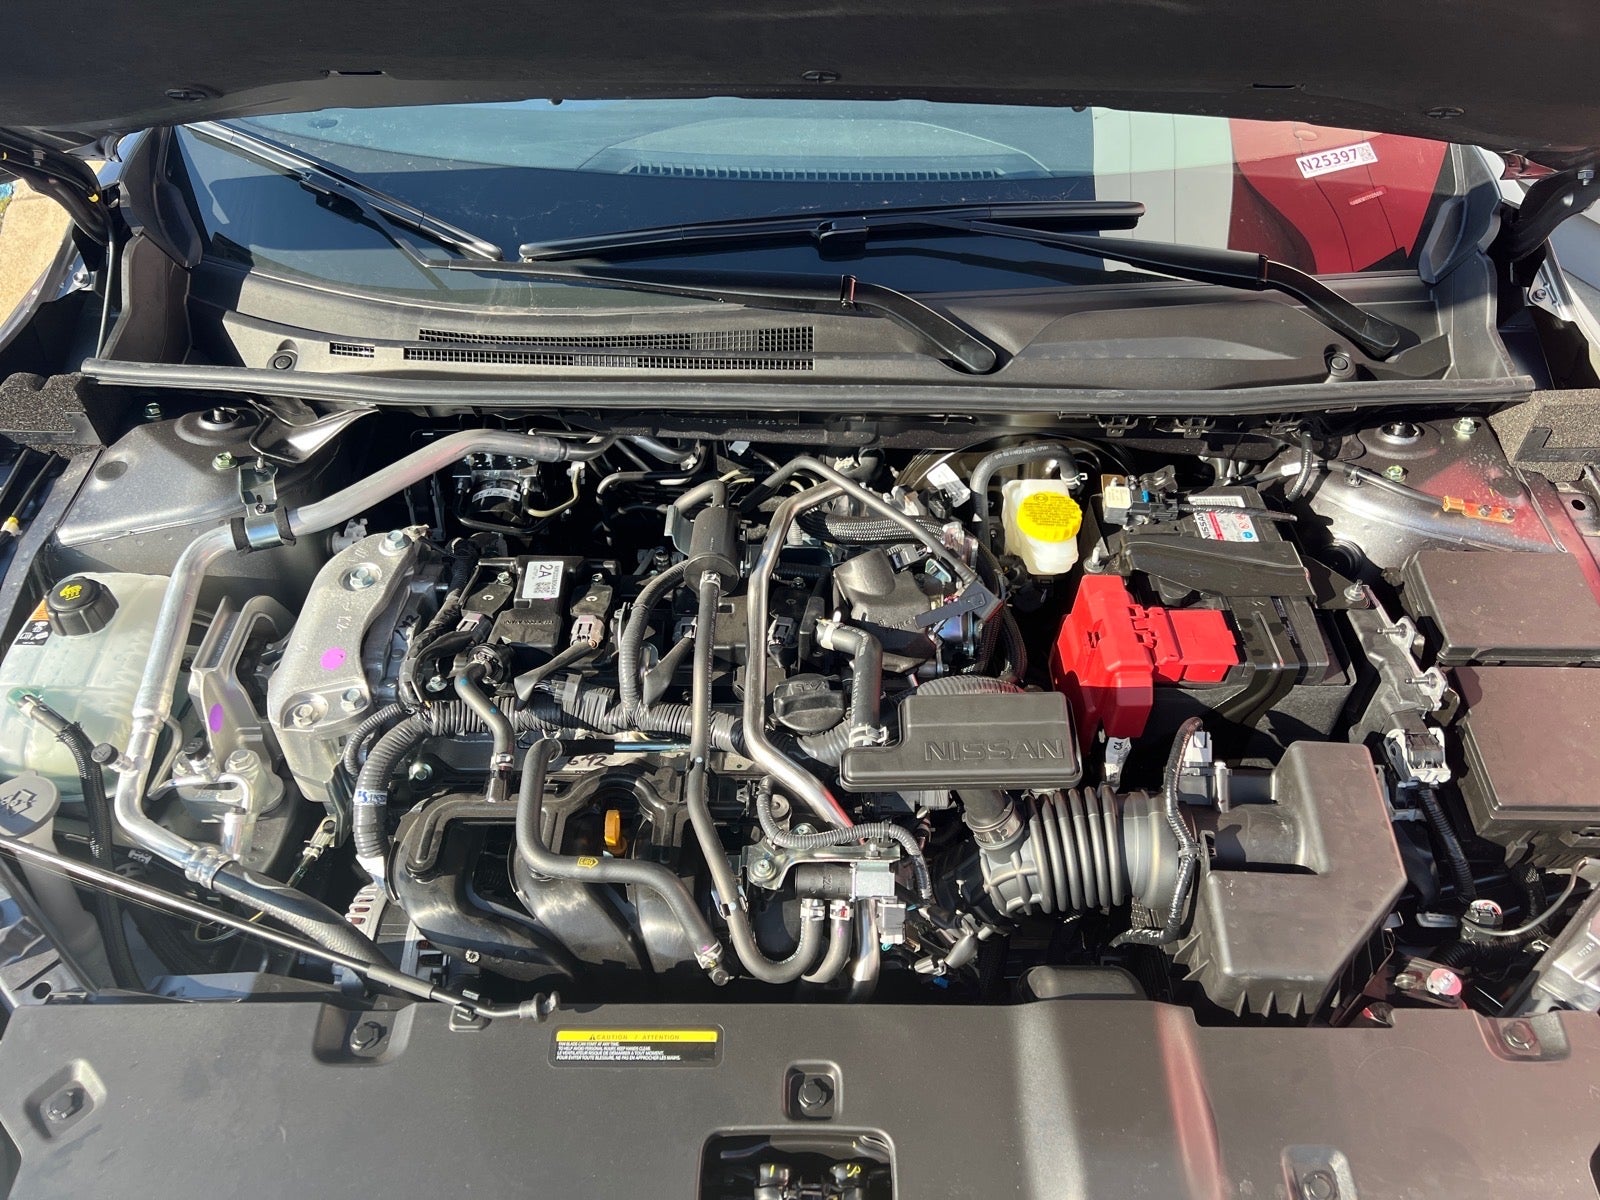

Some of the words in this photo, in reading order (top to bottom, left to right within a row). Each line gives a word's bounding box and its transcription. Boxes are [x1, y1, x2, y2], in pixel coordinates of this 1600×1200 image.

[1300, 148, 1357, 172] N25397
[538, 564, 553, 578] 2A
[923, 739, 1065, 762] NISSAN
